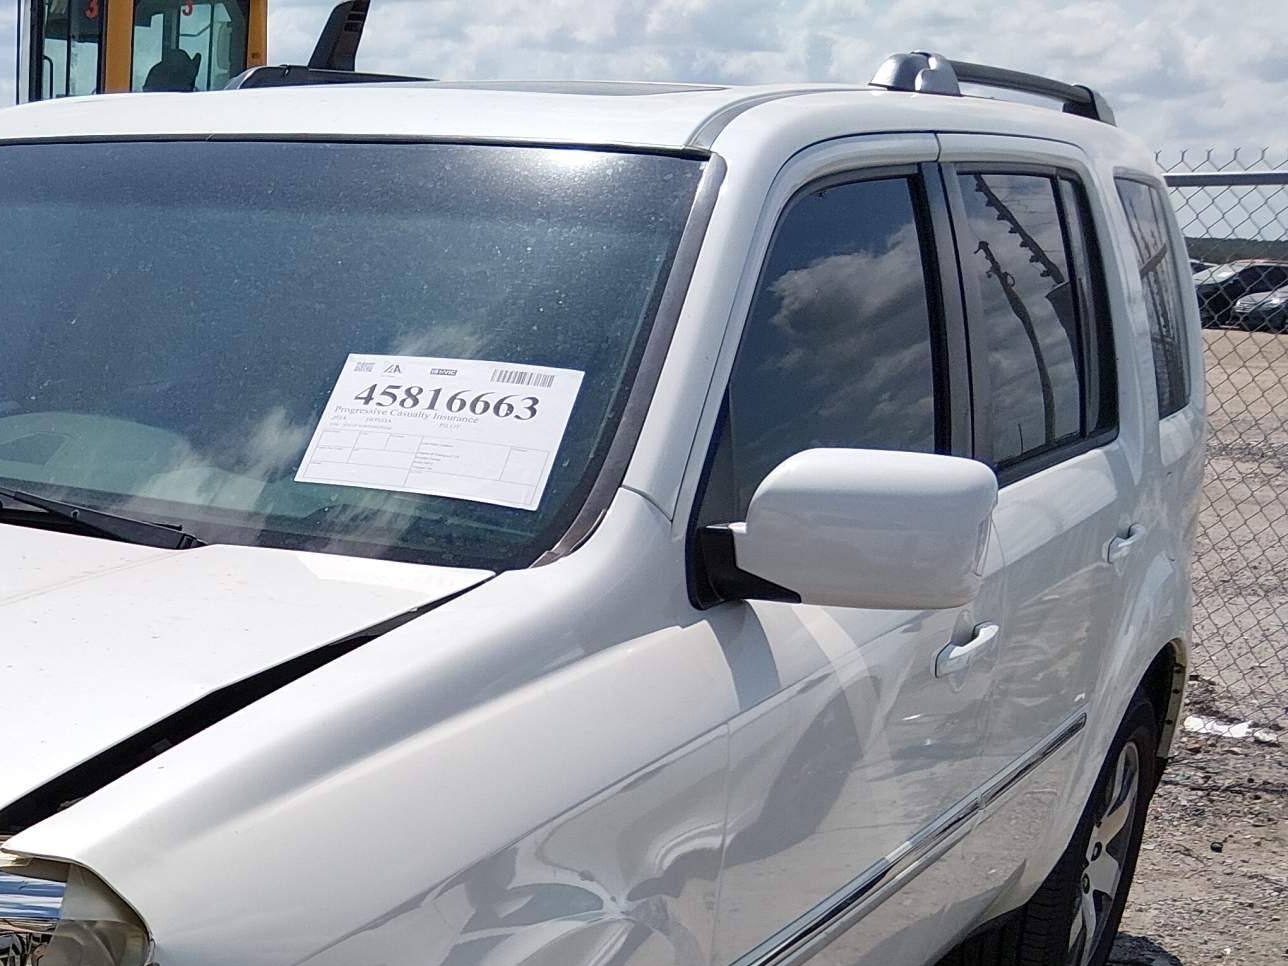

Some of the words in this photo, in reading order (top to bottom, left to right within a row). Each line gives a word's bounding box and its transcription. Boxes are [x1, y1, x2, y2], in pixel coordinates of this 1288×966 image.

[333, 404, 390, 417] Progressive
[390, 409, 432, 420] Casualty
[432, 412, 480, 424] Insurance
[353, 382, 540, 422] 45816663
